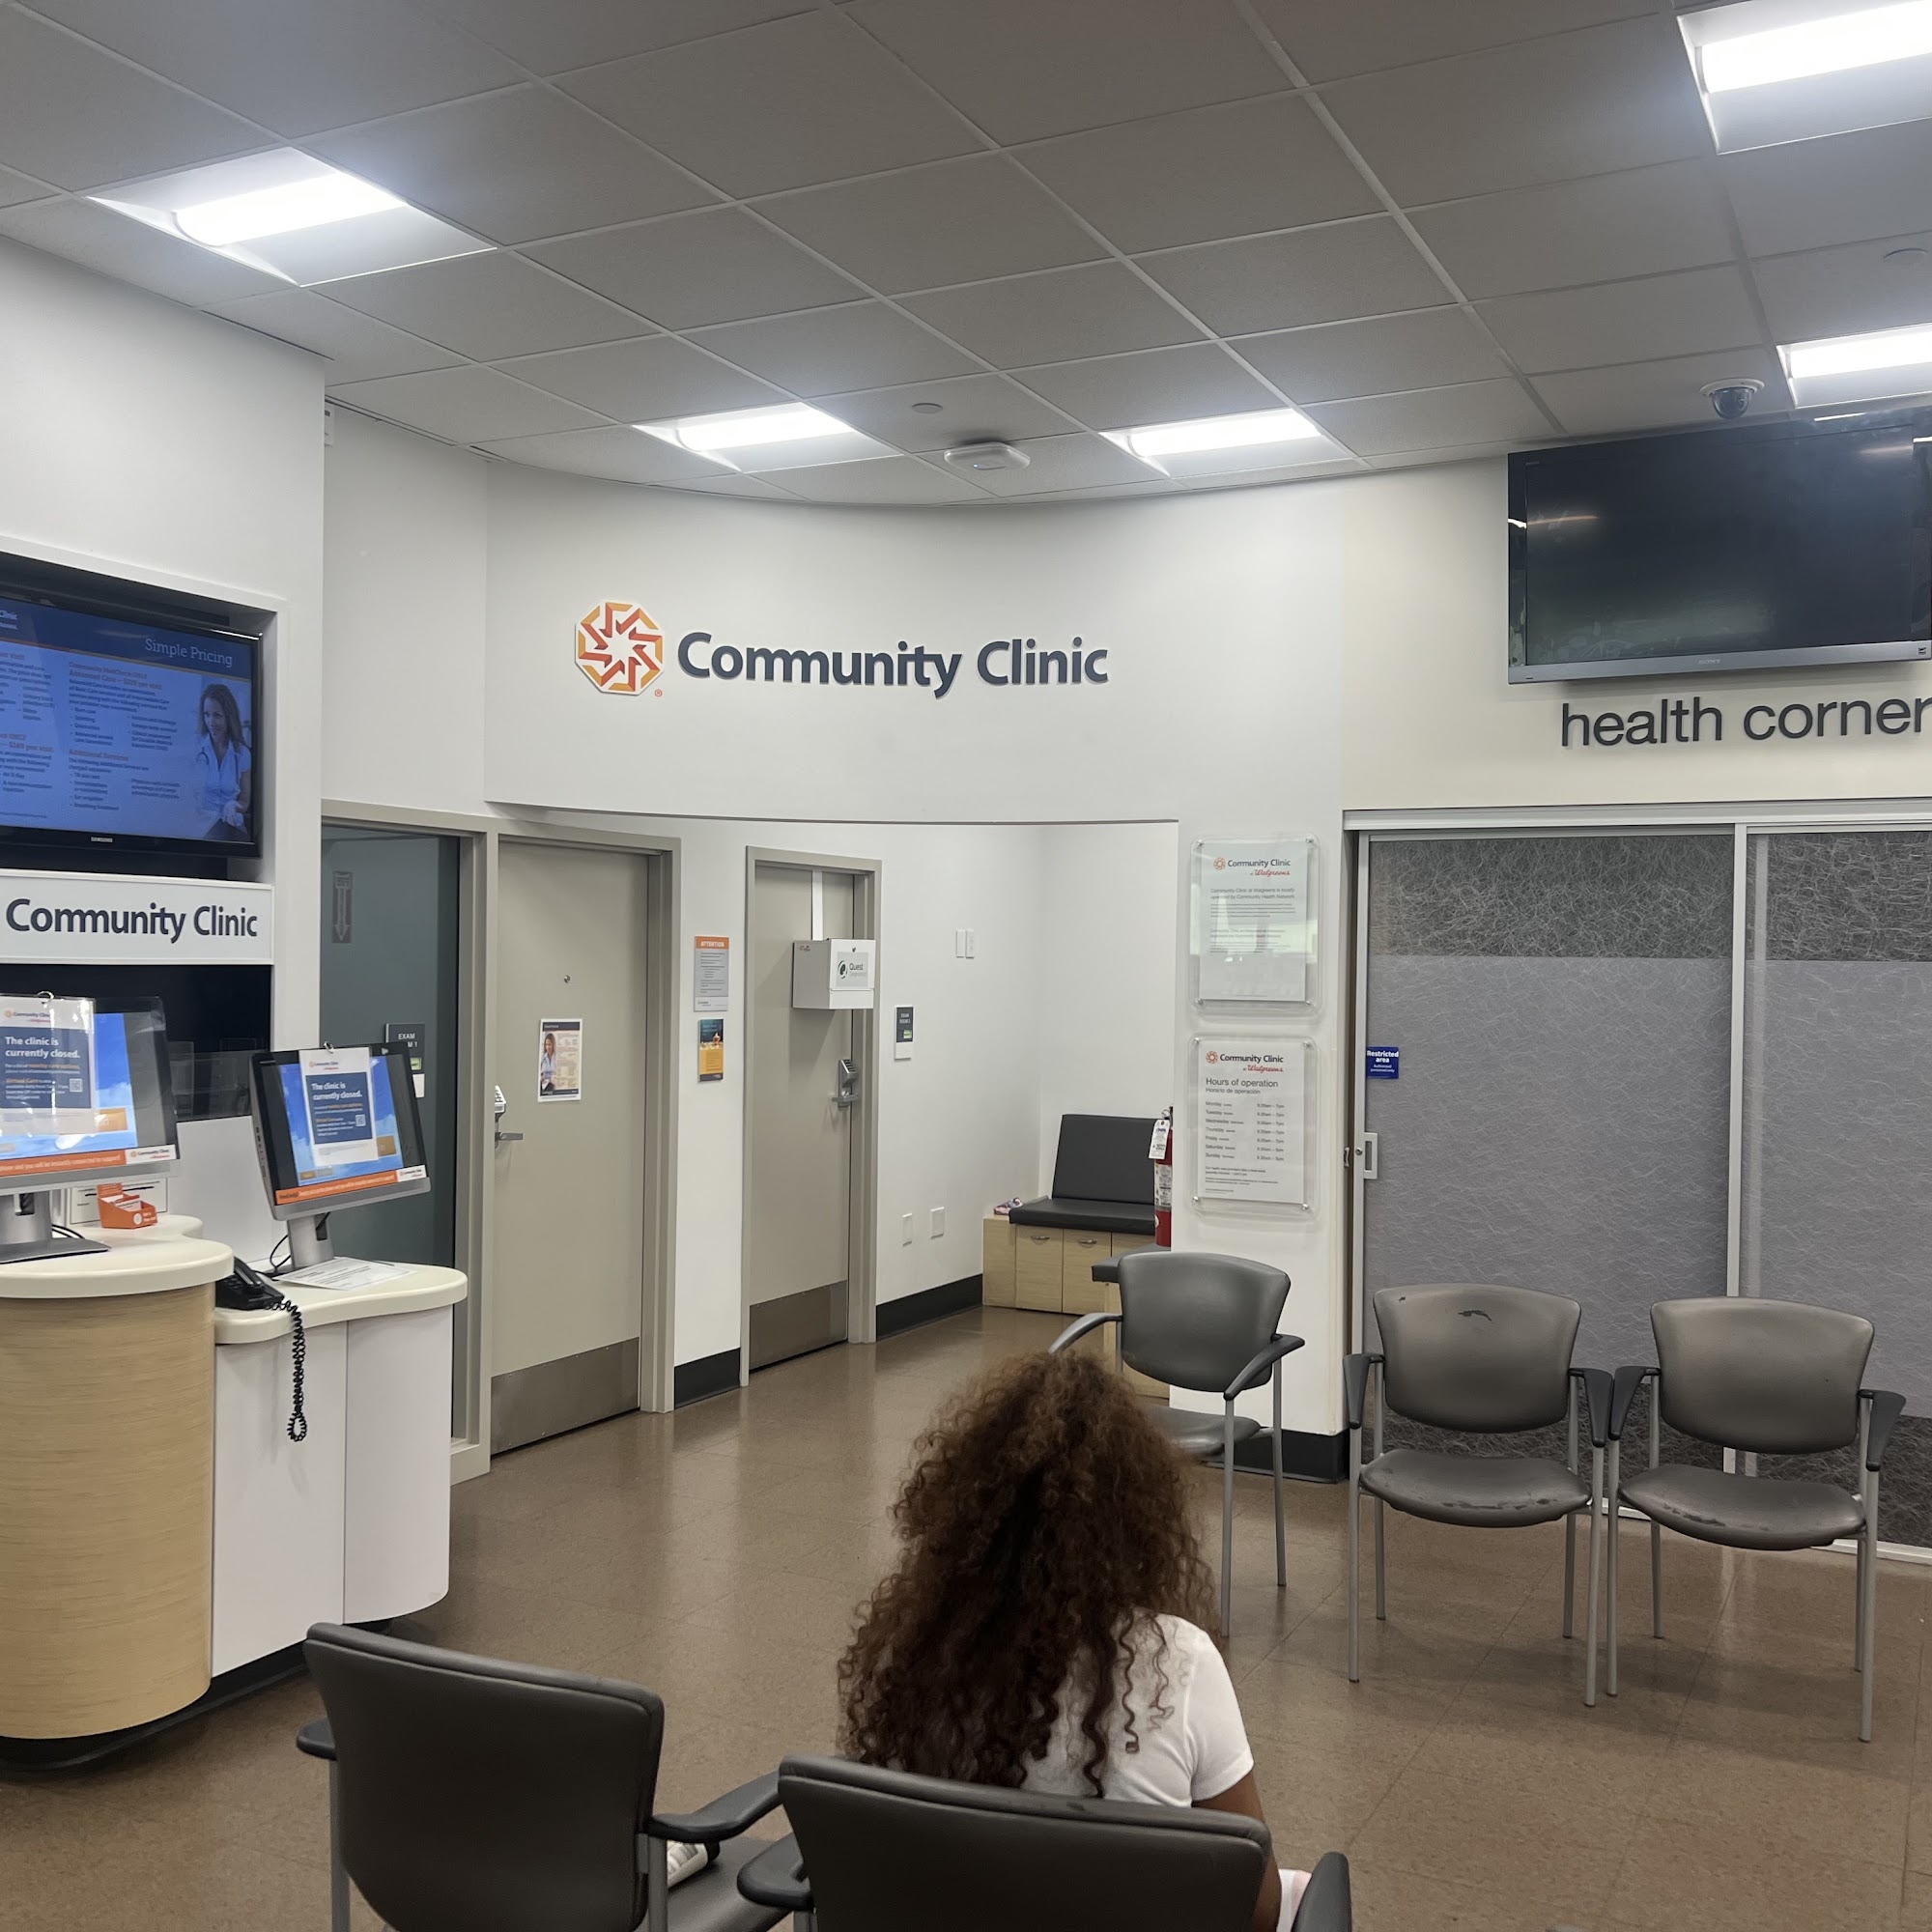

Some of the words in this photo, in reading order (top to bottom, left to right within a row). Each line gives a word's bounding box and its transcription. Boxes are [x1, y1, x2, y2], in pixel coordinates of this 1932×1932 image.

[145, 638, 187, 658] Simple
[190, 646, 232, 668] Pricing
[678, 633, 963, 699] Community
[978, 637, 1109, 686] Clinic
[1562, 696, 1722, 747] health
[1744, 696, 1932, 740] corner
[1228, 860, 1269, 868] Community
[6, 898, 186, 944] Community
[193, 905, 258, 937] Clinic
[849, 962, 864, 971] Quest
[5, 1036, 23, 1045] The
[25, 1037, 49, 1045] clinic
[51, 1037, 59, 1046] is
[5, 1048, 49, 1059] currently
[50, 1049, 80, 1059] closed.
[1220, 1054, 1262, 1064] Community
[1247, 1065, 1284, 1073] Walgreens
